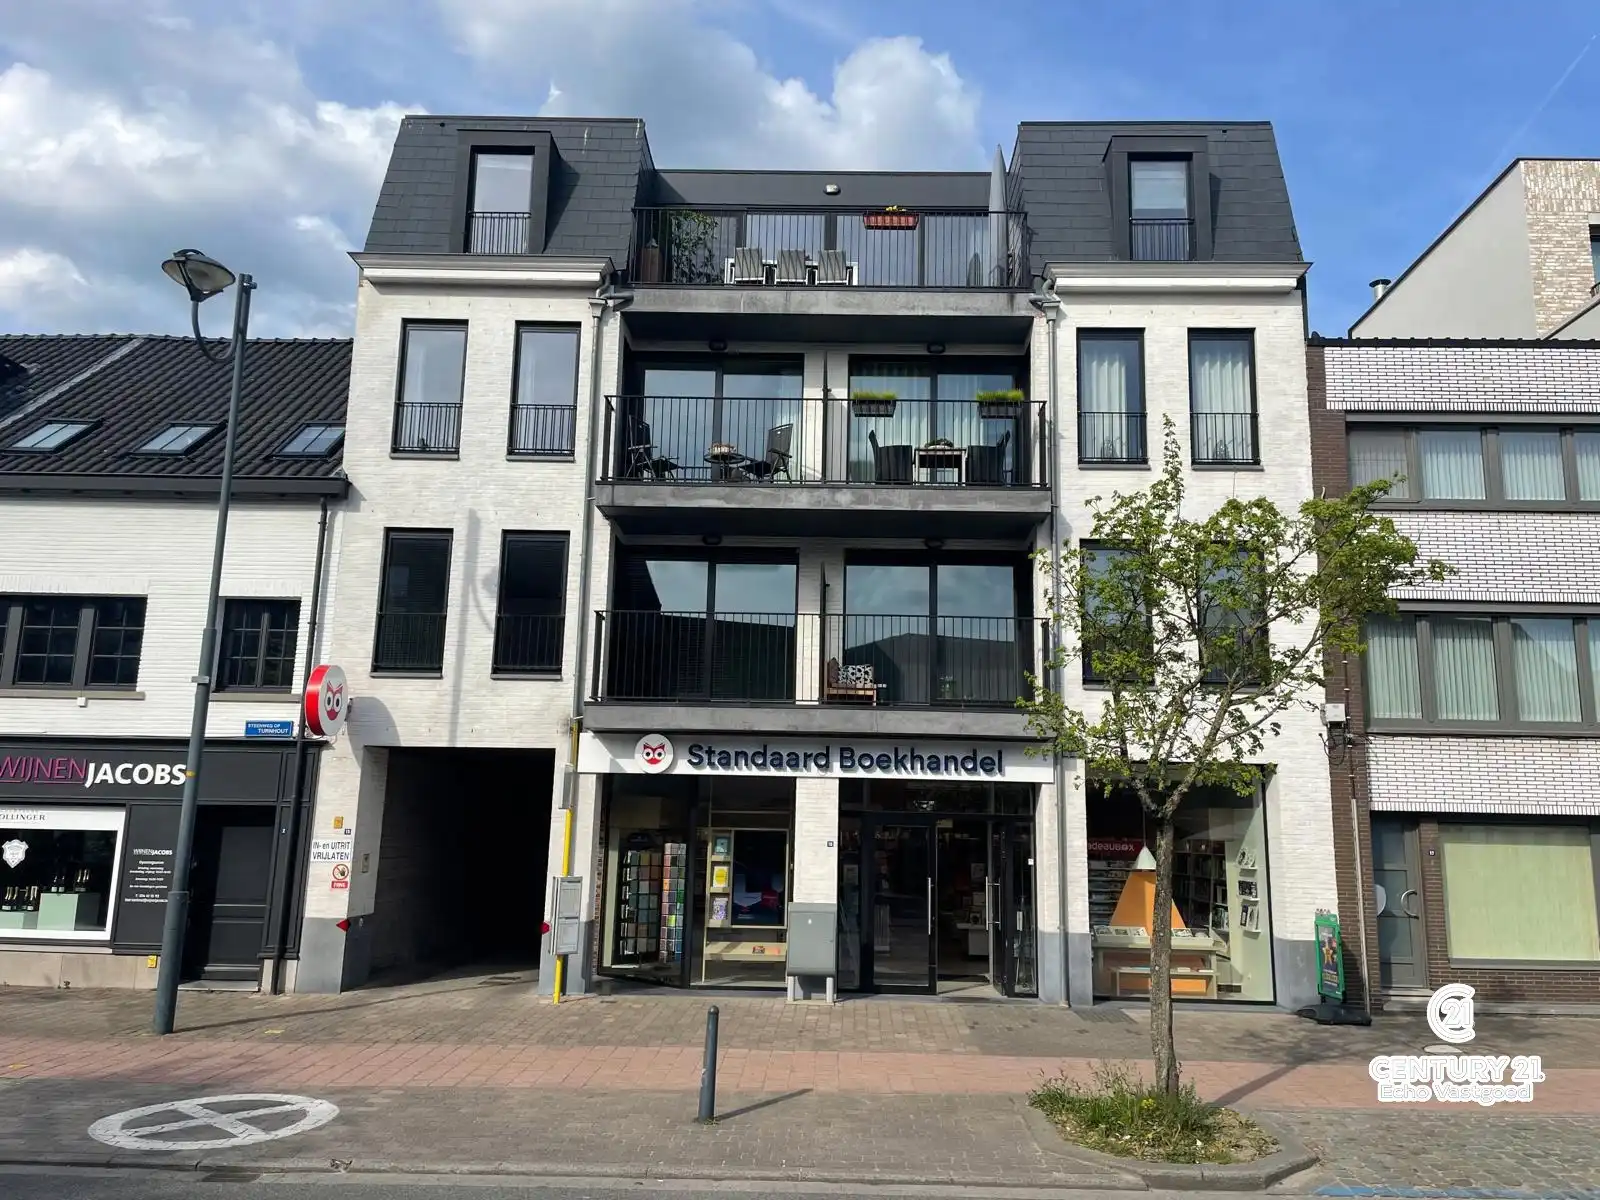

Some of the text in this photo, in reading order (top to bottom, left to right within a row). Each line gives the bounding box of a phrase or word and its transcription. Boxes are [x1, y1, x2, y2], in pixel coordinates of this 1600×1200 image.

[688, 744, 1003, 773] Standaard Boekhandel
[331, 842, 350, 850] UITRIT
[313, 851, 349, 860] VRIJLATEN
